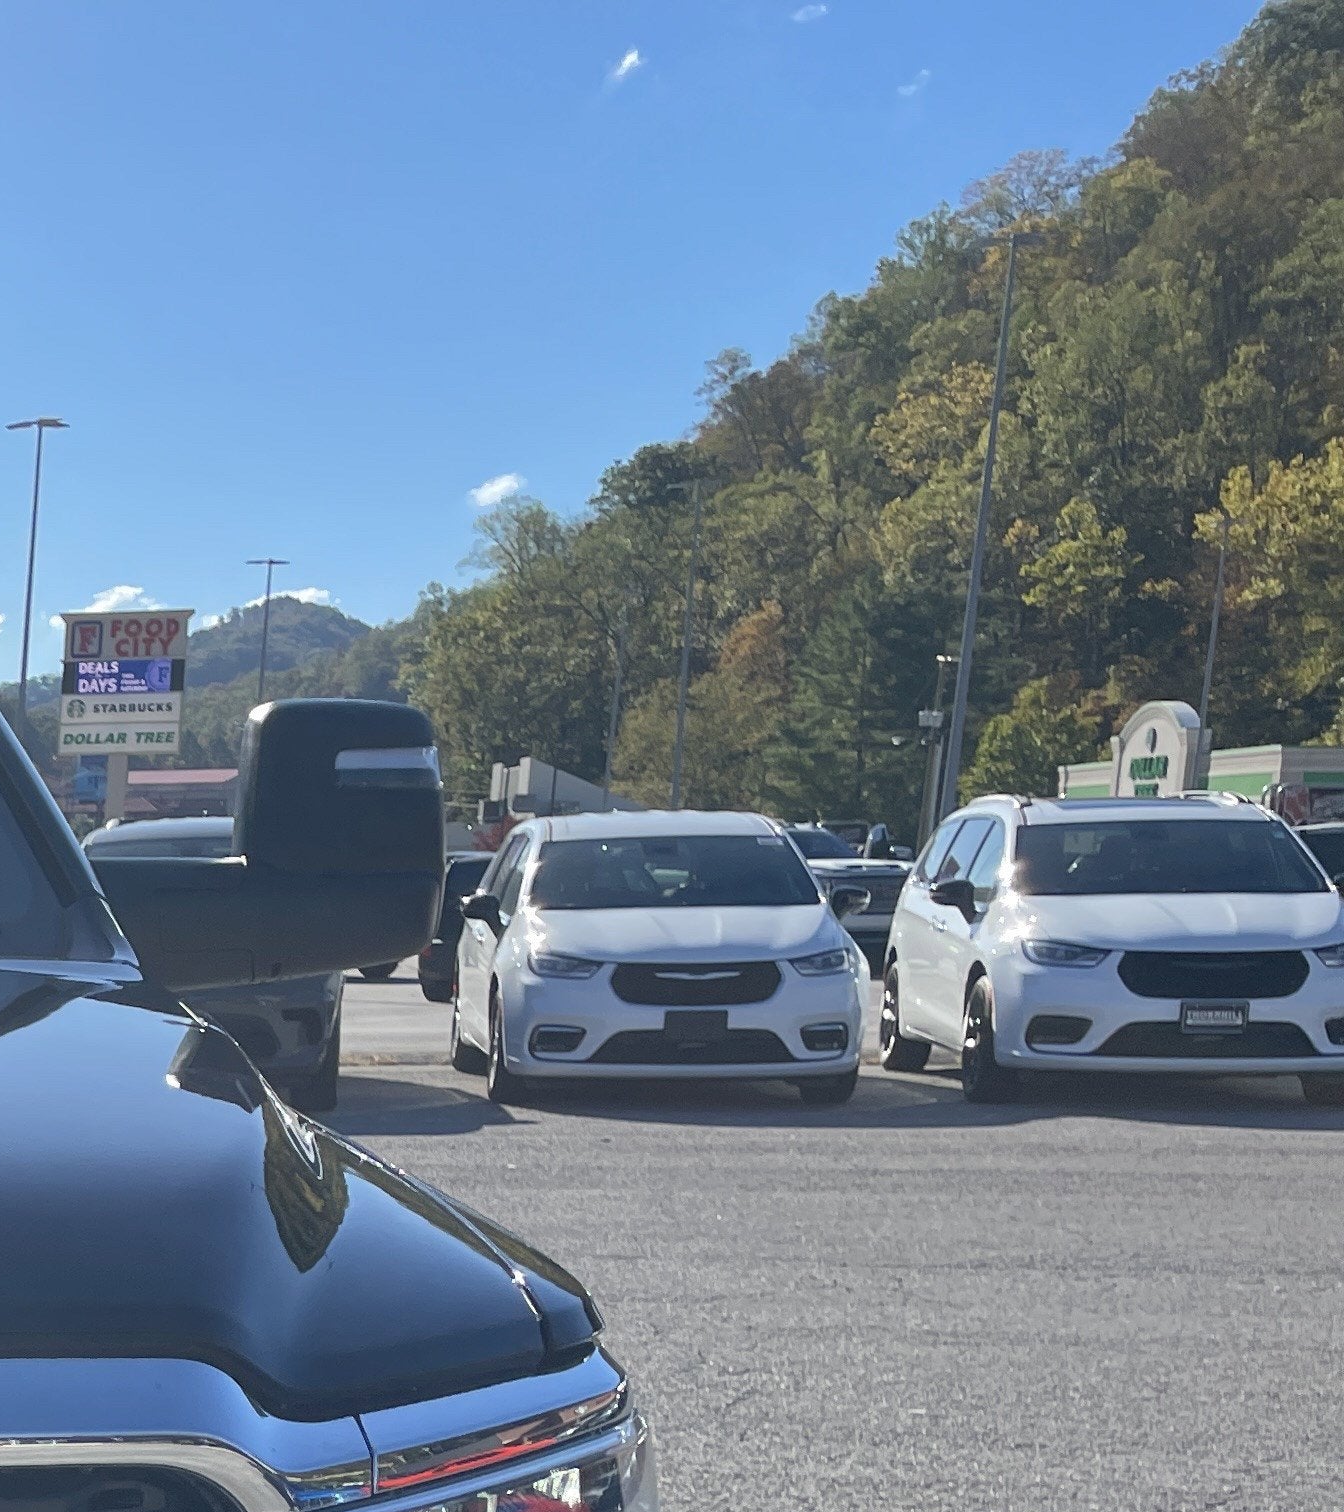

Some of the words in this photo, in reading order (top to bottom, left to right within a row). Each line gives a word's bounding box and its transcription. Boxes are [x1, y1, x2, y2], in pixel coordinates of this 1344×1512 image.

[110, 618, 180, 638] FOOD
[115, 637, 173, 657] CITY
[78, 661, 119, 674] DEALS
[77, 678, 117, 693] DAYS
[93, 702, 173, 713] STARBUCKS
[63, 732, 127, 745] DOLLAR
[135, 731, 175, 744] TREE
